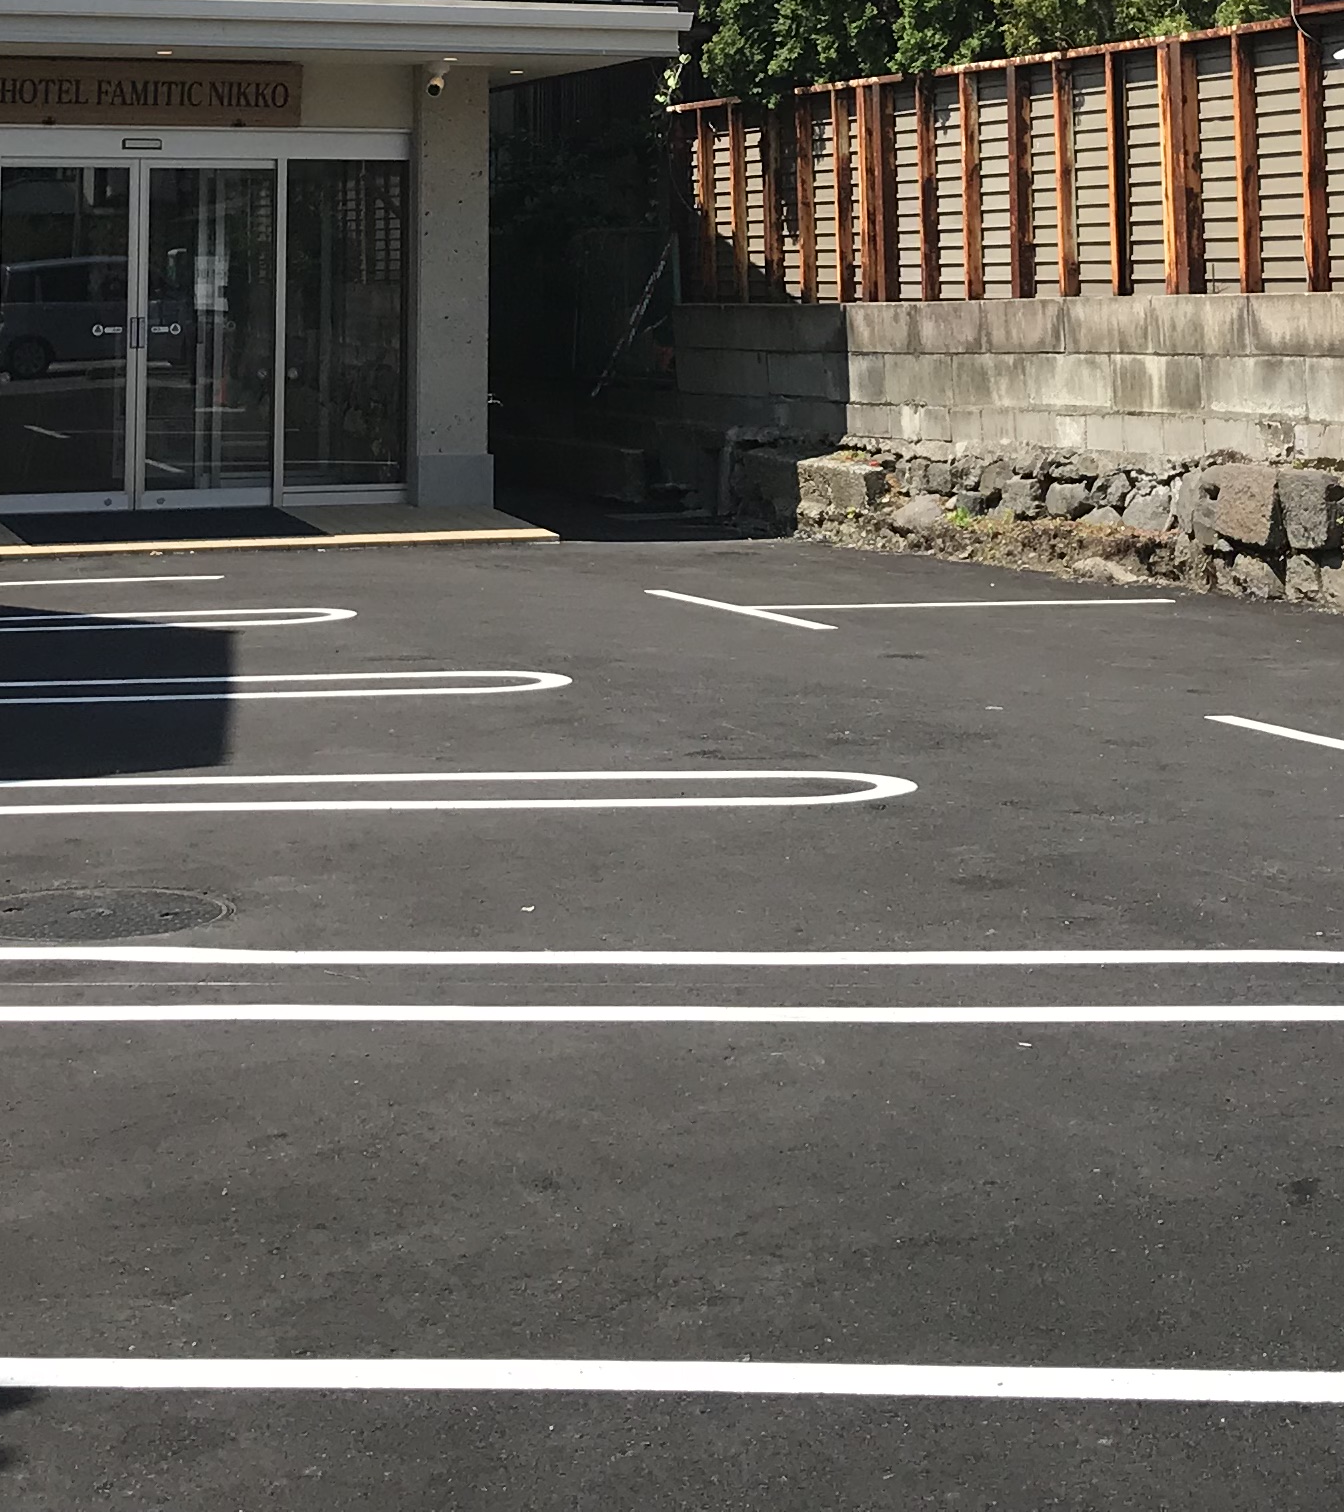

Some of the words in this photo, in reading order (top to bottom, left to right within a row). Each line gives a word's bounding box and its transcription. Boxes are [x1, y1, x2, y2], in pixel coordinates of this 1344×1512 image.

[0, 77, 89, 105] HOTEL
[96, 79, 203, 107] FAMITIC
[208, 81, 290, 109] NIKKO
